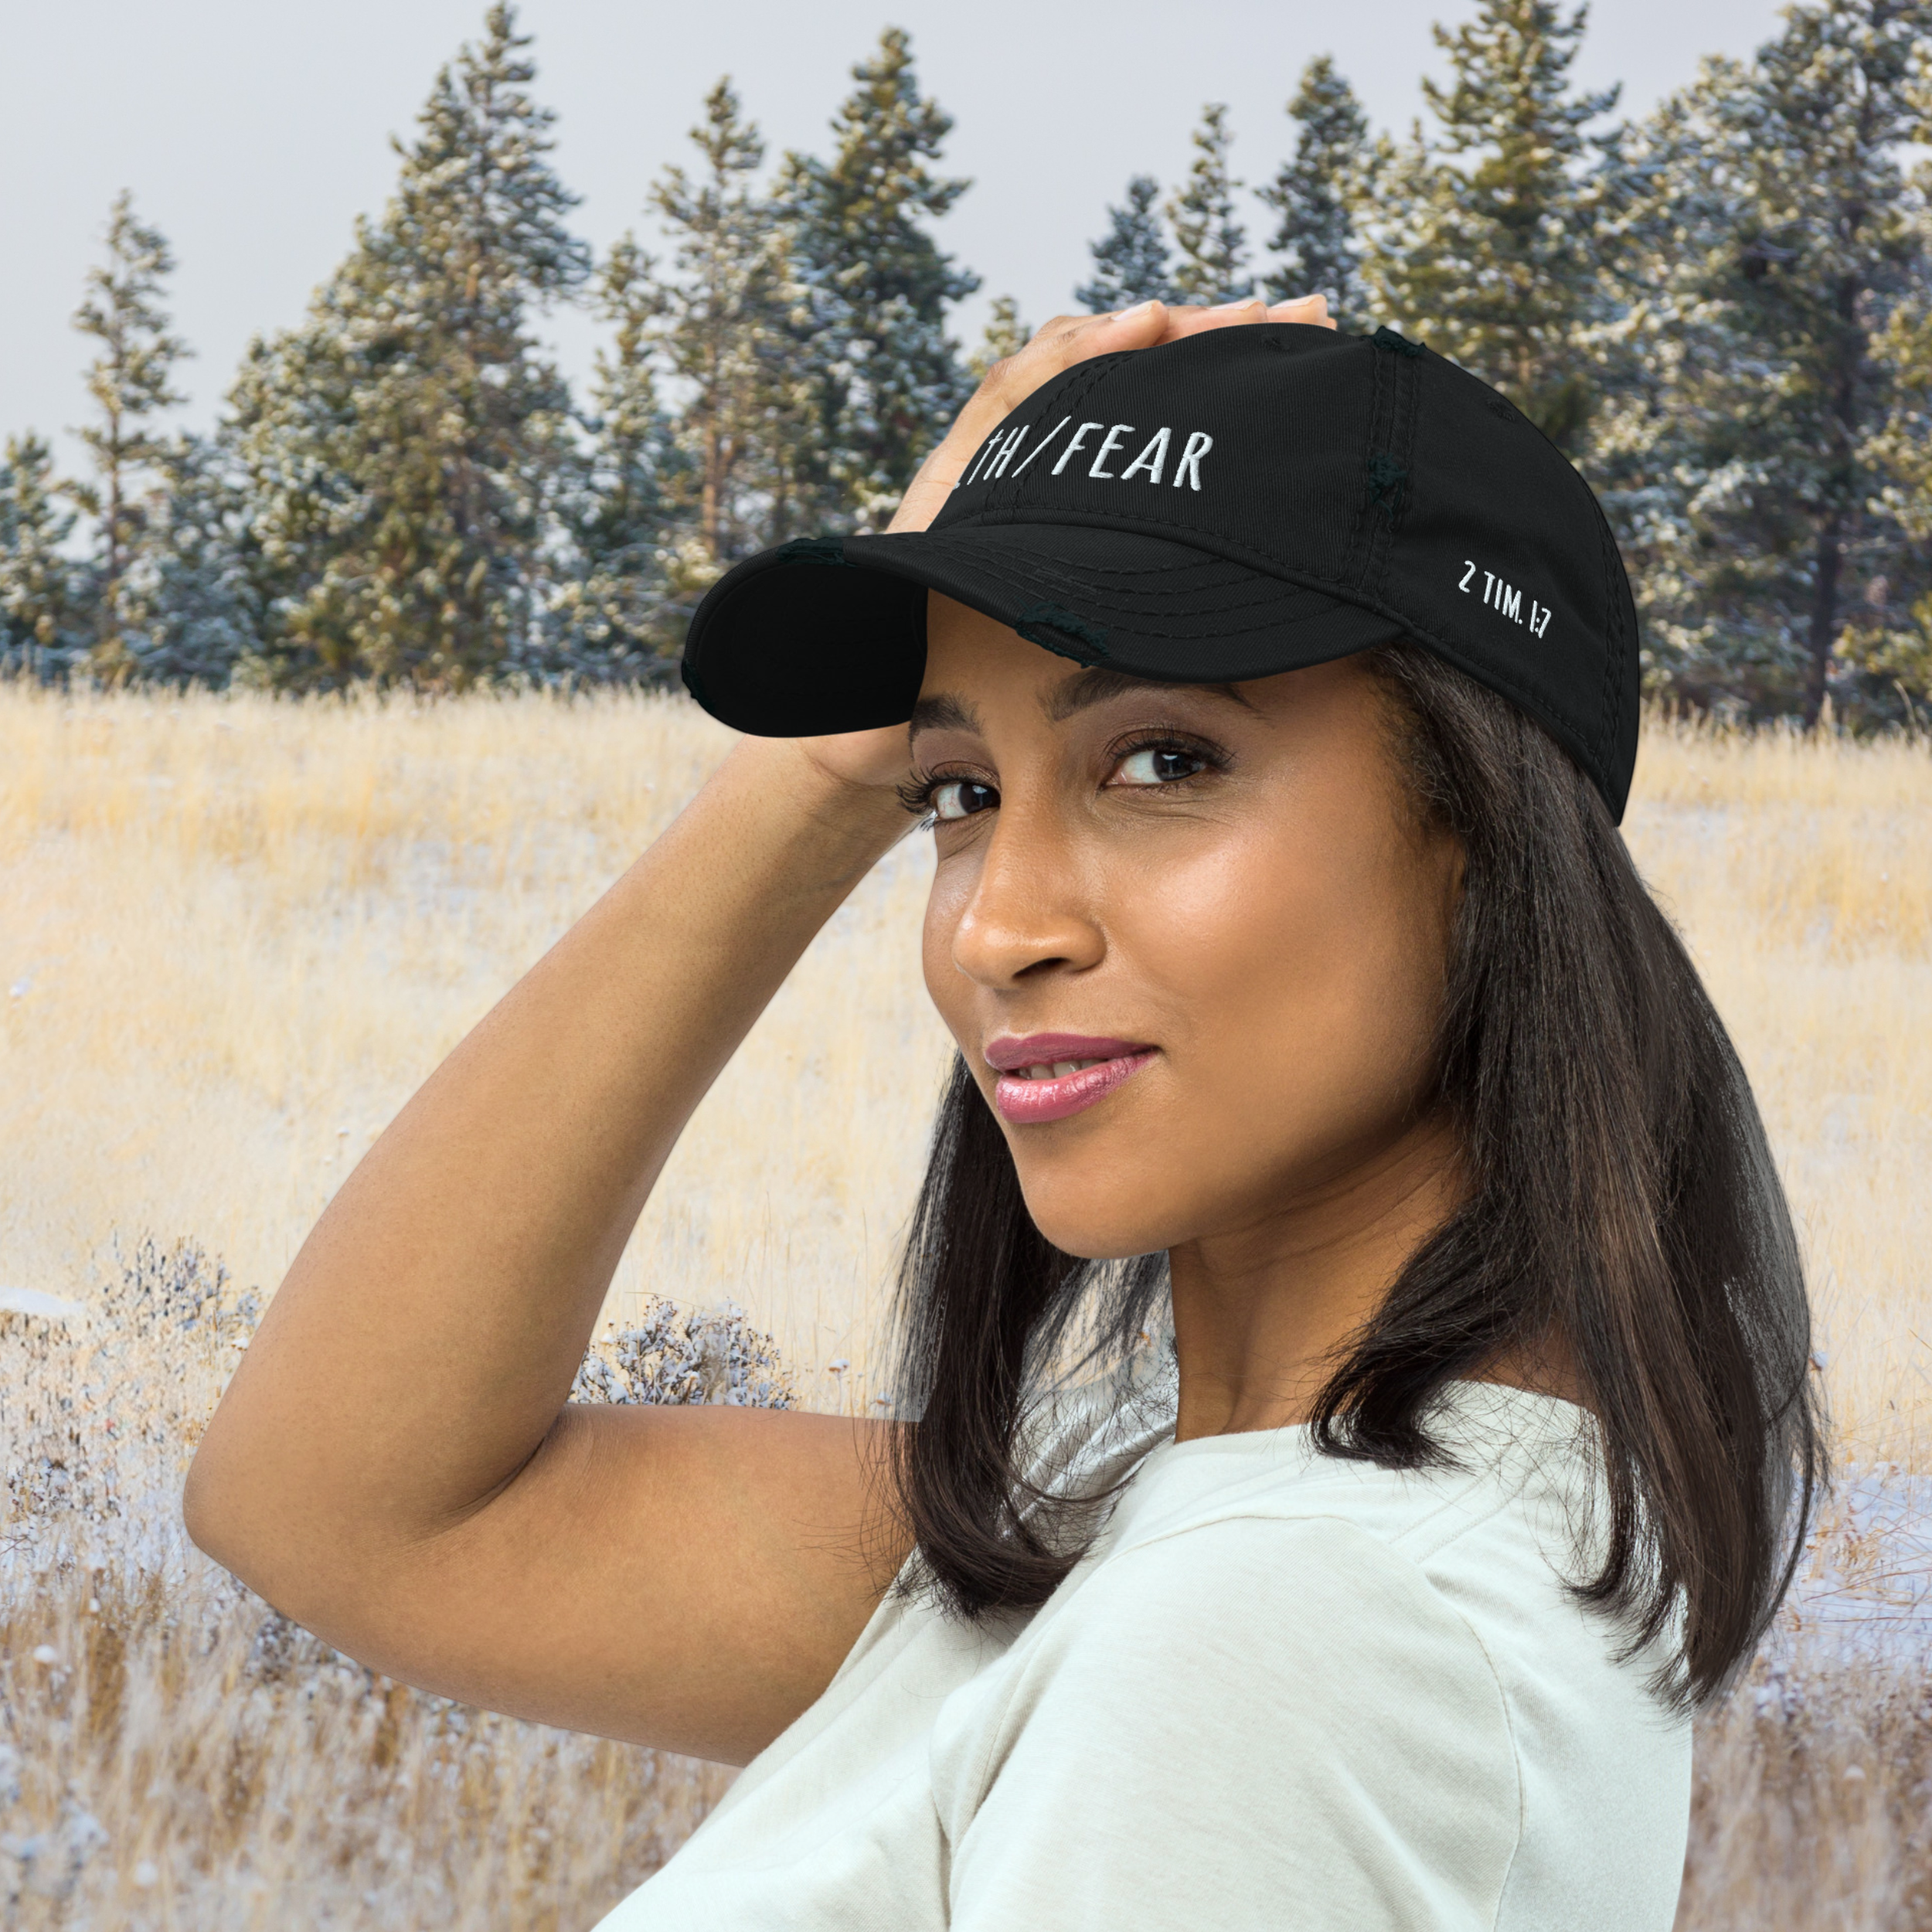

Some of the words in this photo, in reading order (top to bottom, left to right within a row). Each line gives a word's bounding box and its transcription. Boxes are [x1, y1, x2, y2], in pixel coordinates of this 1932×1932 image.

[1458, 560, 1477, 594] 2
[1483, 570, 1523, 624] TIM.
[1529, 600, 1552, 639] 1:7
